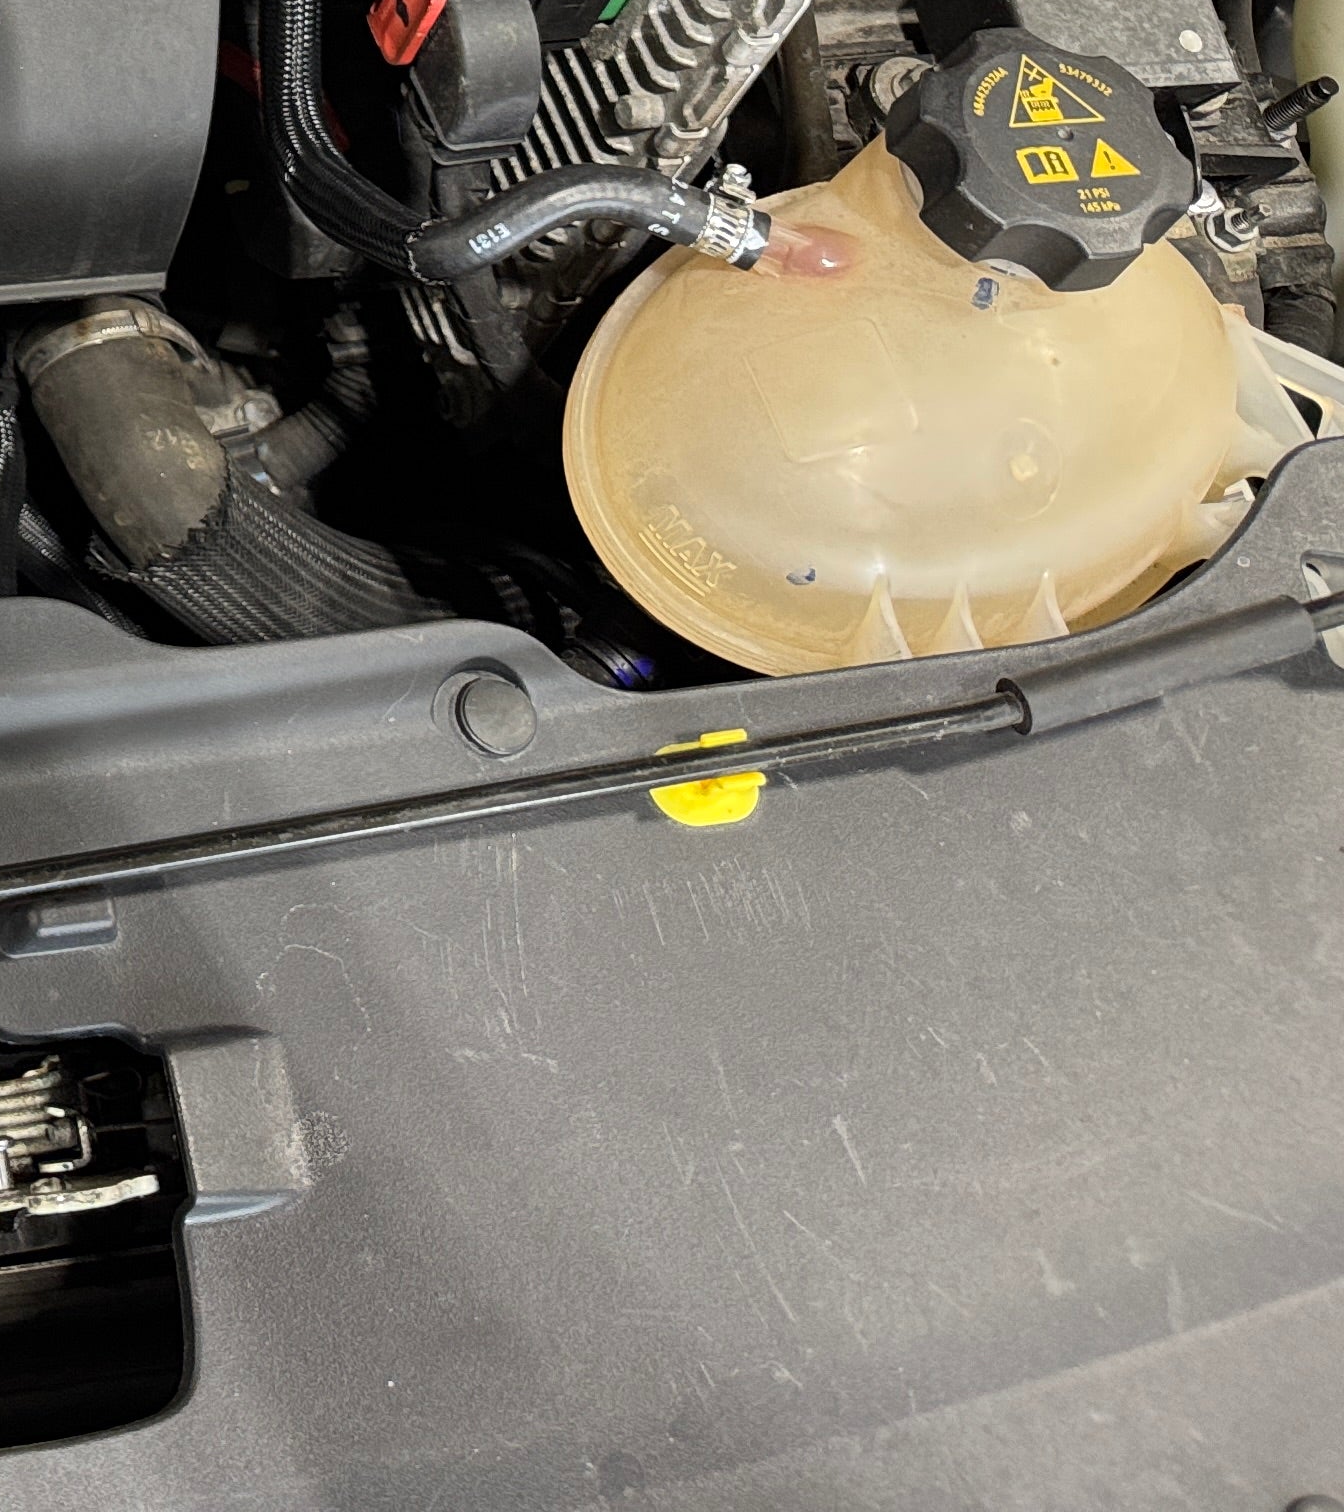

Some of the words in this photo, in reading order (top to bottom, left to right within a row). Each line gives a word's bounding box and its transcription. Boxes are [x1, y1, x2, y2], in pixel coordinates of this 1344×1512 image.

[1076, 188, 1092, 199] 21
[1091, 186, 1110, 199] PSI
[1079, 201, 1101, 213] 145
[1100, 199, 1121, 212] kPa
[469, 223, 511, 254] E131
[648, 504, 737, 588] MAX
